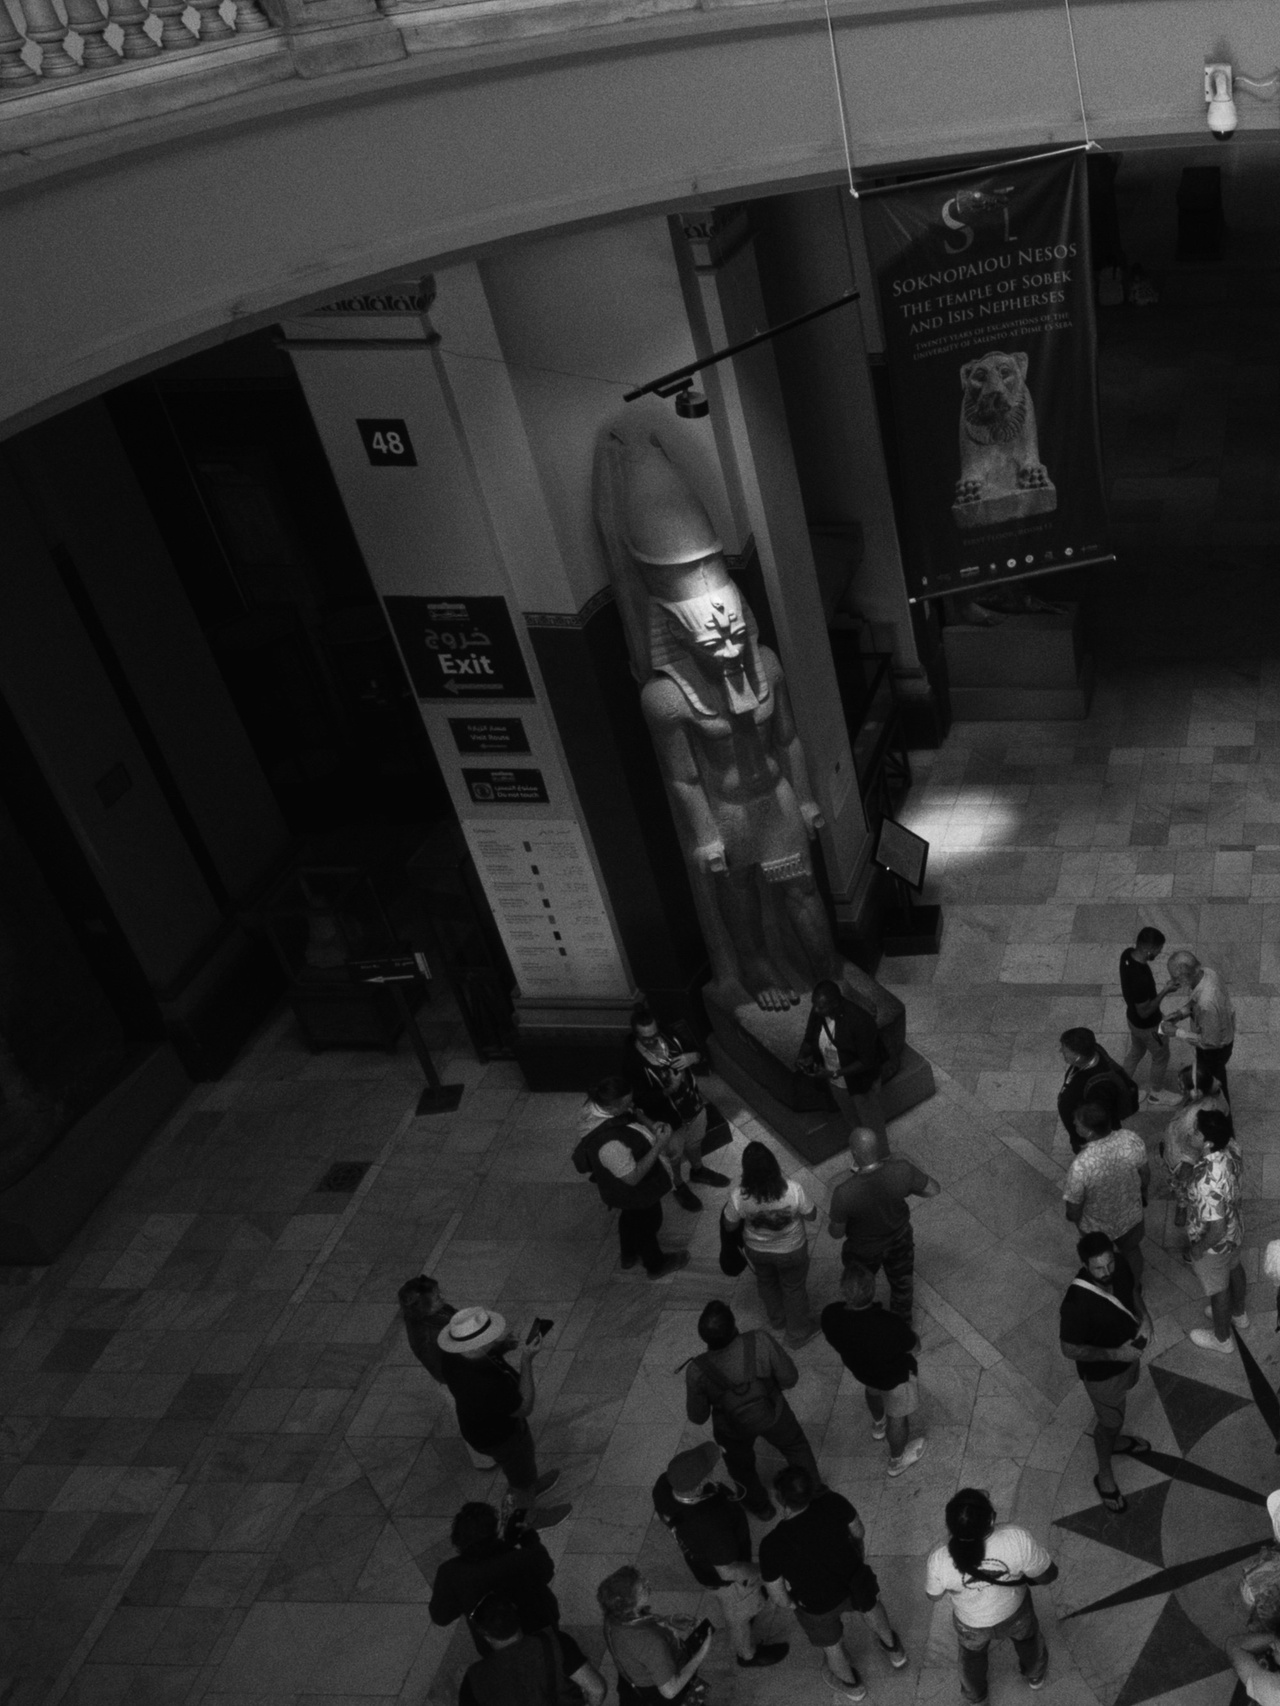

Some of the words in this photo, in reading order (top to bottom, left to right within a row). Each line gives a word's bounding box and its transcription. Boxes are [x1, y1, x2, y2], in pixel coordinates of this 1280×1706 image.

[892, 253, 1012, 297] SOKNOPAIOU
[1017, 242, 1078, 267] NESOS
[900, 301, 933, 318] THE
[935, 284, 993, 309] TEMPLE
[996, 279, 1019, 294] OF
[1022, 270, 1073, 290] SOBEK
[908, 315, 944, 337] AND
[948, 307, 975, 325] ISIS
[978, 289, 1066, 318] NEPHERSES
[912, 341, 959, 361] UNIVERSITY
[960, 338, 971, 348] OF
[973, 331, 1008, 346] SALENTO
[914, 335, 948, 351] TWENTY
[949, 330, 973, 343] YEARS
[974, 327, 986, 336] OF
[987, 317, 1039, 333] EXCAVATIONS
[371, 431, 405, 455] 48
[424, 627, 494, 651] خروج
[437, 653, 495, 676] Exit
